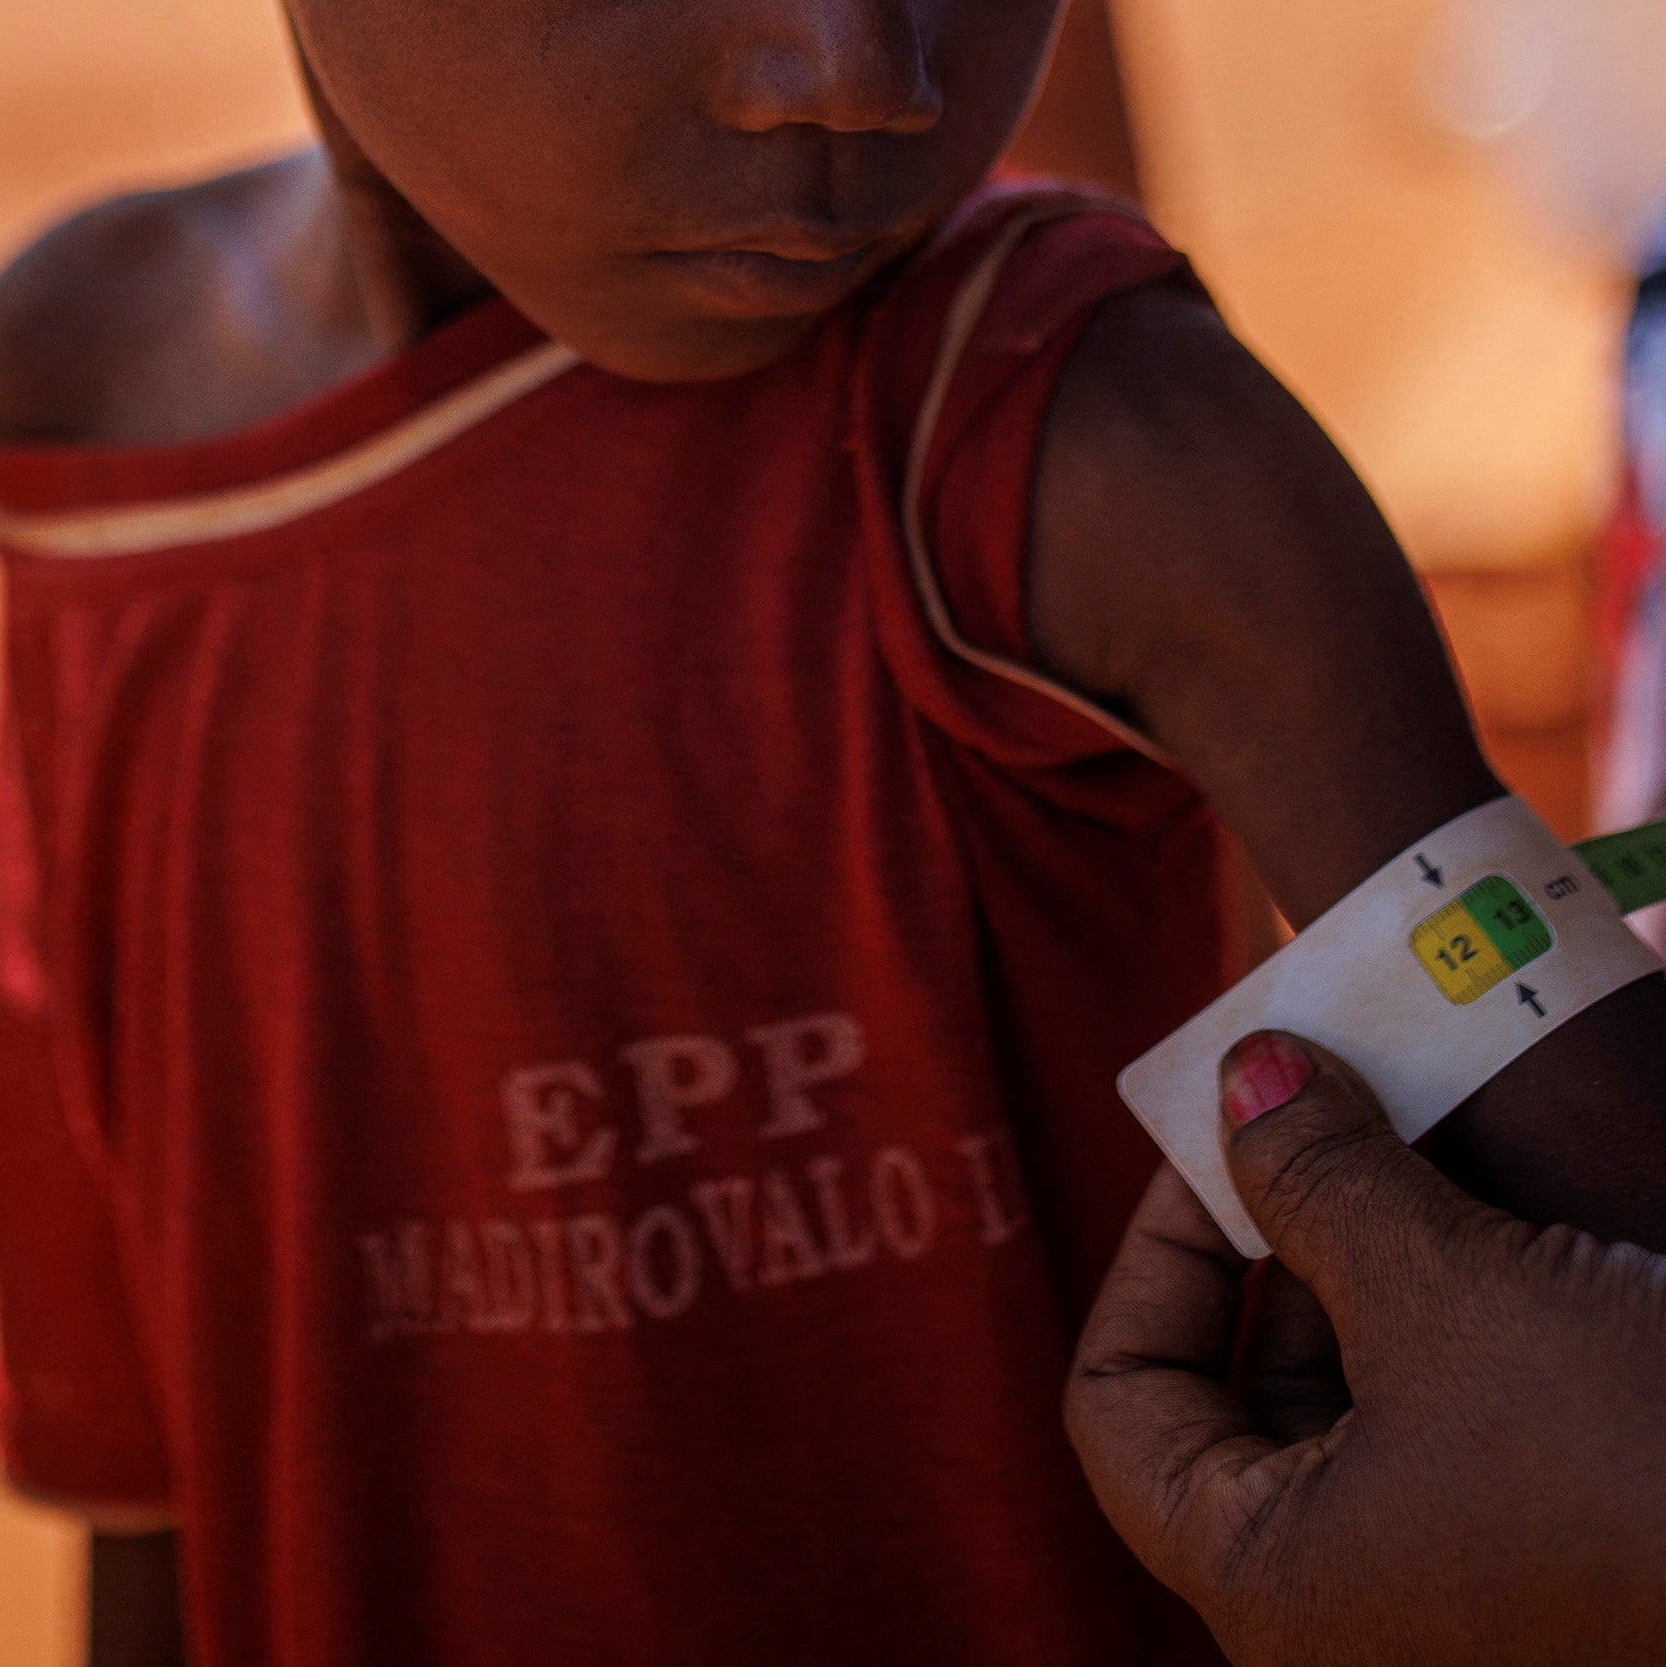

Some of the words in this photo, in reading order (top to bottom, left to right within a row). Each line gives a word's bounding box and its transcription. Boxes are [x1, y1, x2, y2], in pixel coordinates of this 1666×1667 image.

[1435, 934, 1479, 971] 12
[1494, 899, 1534, 930] 13
[1545, 875, 1579, 900] cm
[501, 1013, 867, 1191] EPP
[355, 1146, 935, 1336] MADIROVALO
